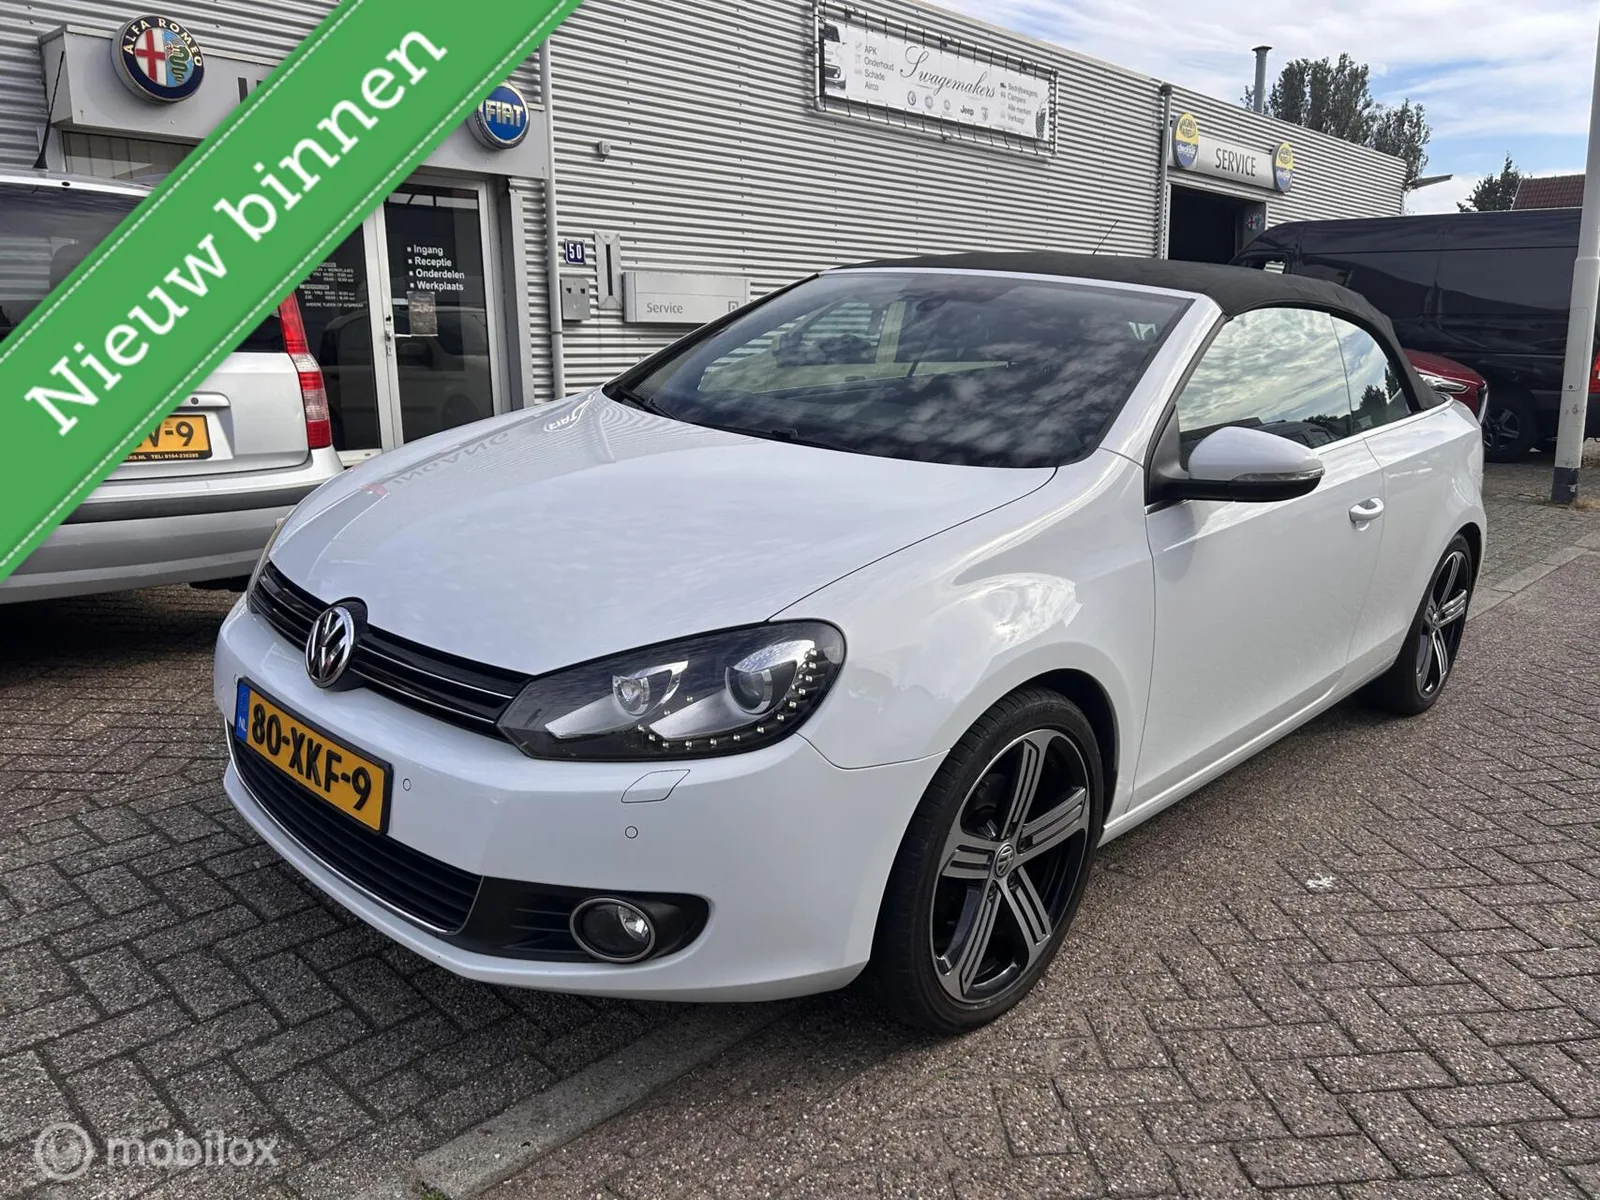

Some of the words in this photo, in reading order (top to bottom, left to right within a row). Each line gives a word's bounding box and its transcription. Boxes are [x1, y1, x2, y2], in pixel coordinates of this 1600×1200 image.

[123, 20, 151, 55] ALFA
[158, 18, 203, 67] ROMEO
[864, 45, 878, 55] APK
[864, 56, 894, 71] Onderhoud
[864, 69, 885, 81] Schade
[900, 45, 995, 98] Swagemakers
[864, 81, 879, 91] Airco
[485, 99, 523, 127] FIAT
[960, 105, 974, 116] Jeep
[1215, 147, 1256, 177] SERVICE
[413, 244, 443, 256] Ingang
[569, 243, 582, 259] 50
[415, 256, 452, 268] Receptie
[416, 268, 465, 280] Onderdelen
[416, 280, 464, 292] Werkplaats
[646, 302, 683, 314] Service
[252, 703, 372, 811] 80-XKF-9
